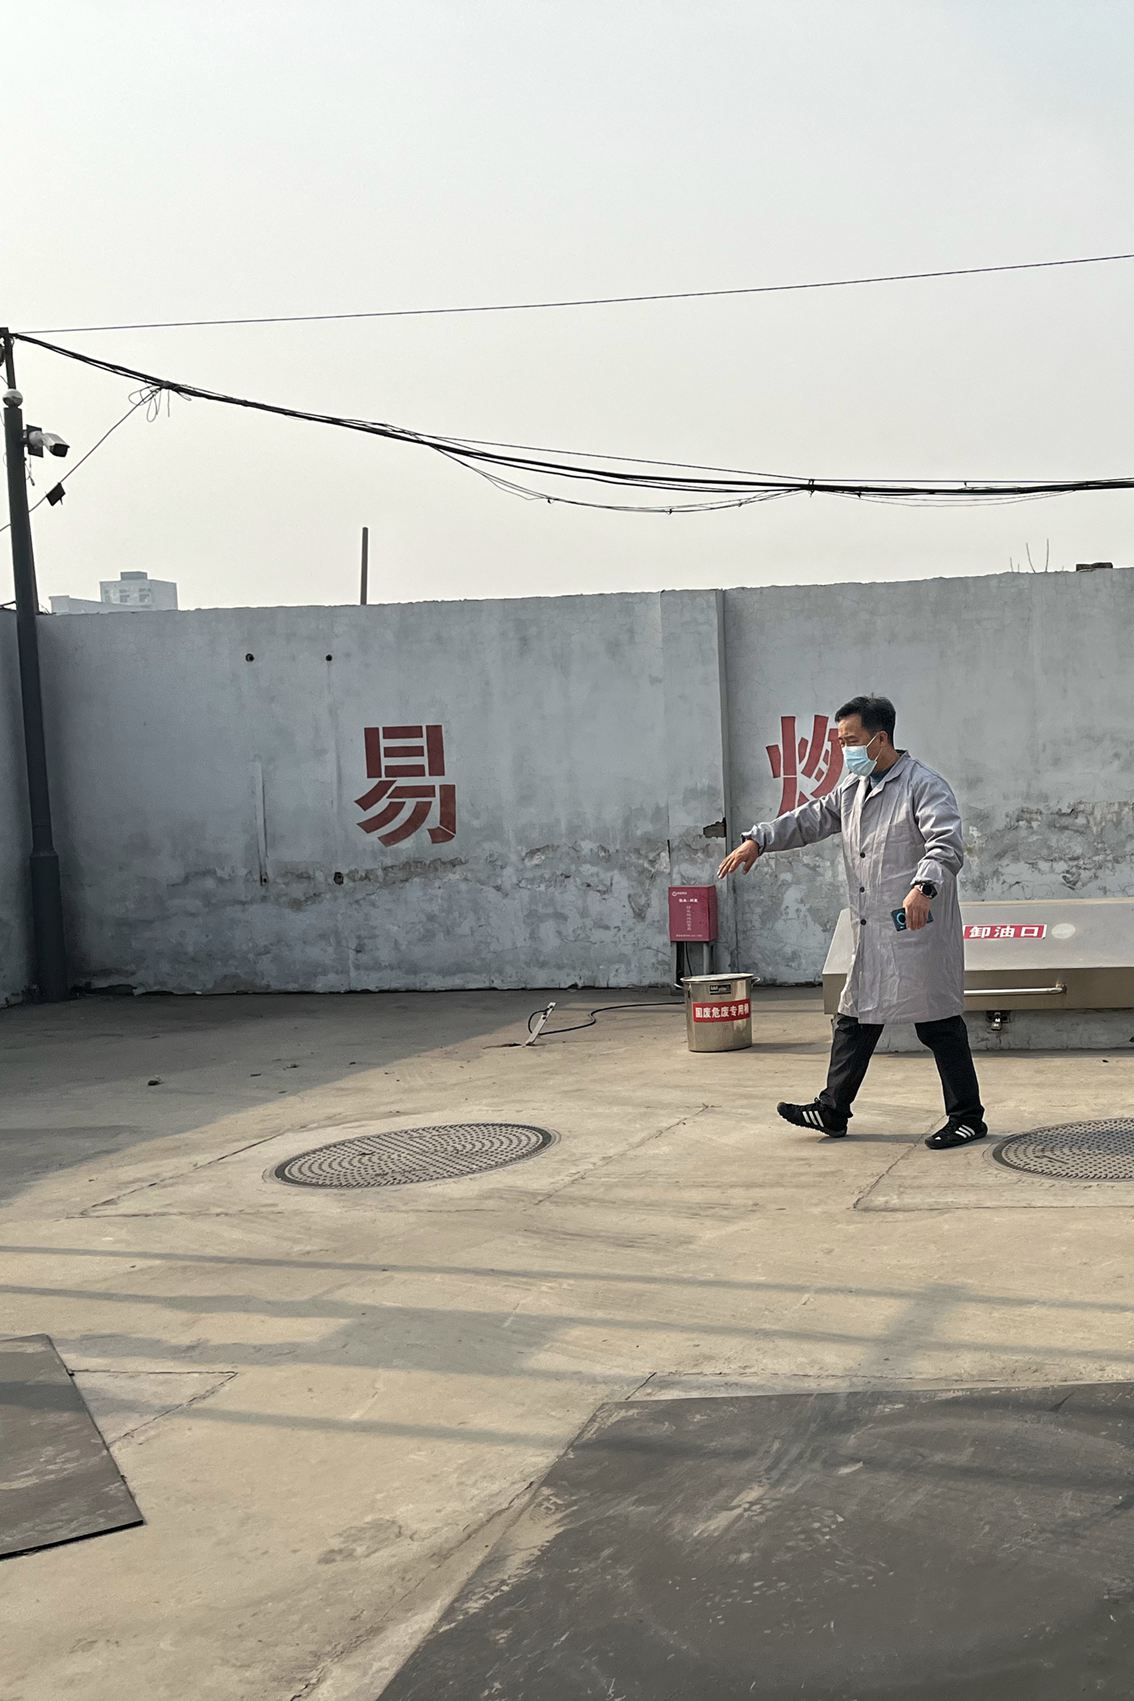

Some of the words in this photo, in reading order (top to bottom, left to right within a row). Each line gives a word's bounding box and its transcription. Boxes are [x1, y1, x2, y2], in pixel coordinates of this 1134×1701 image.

[354, 725, 456, 848] 易
[969, 926, 1039, 938] 卸油口
